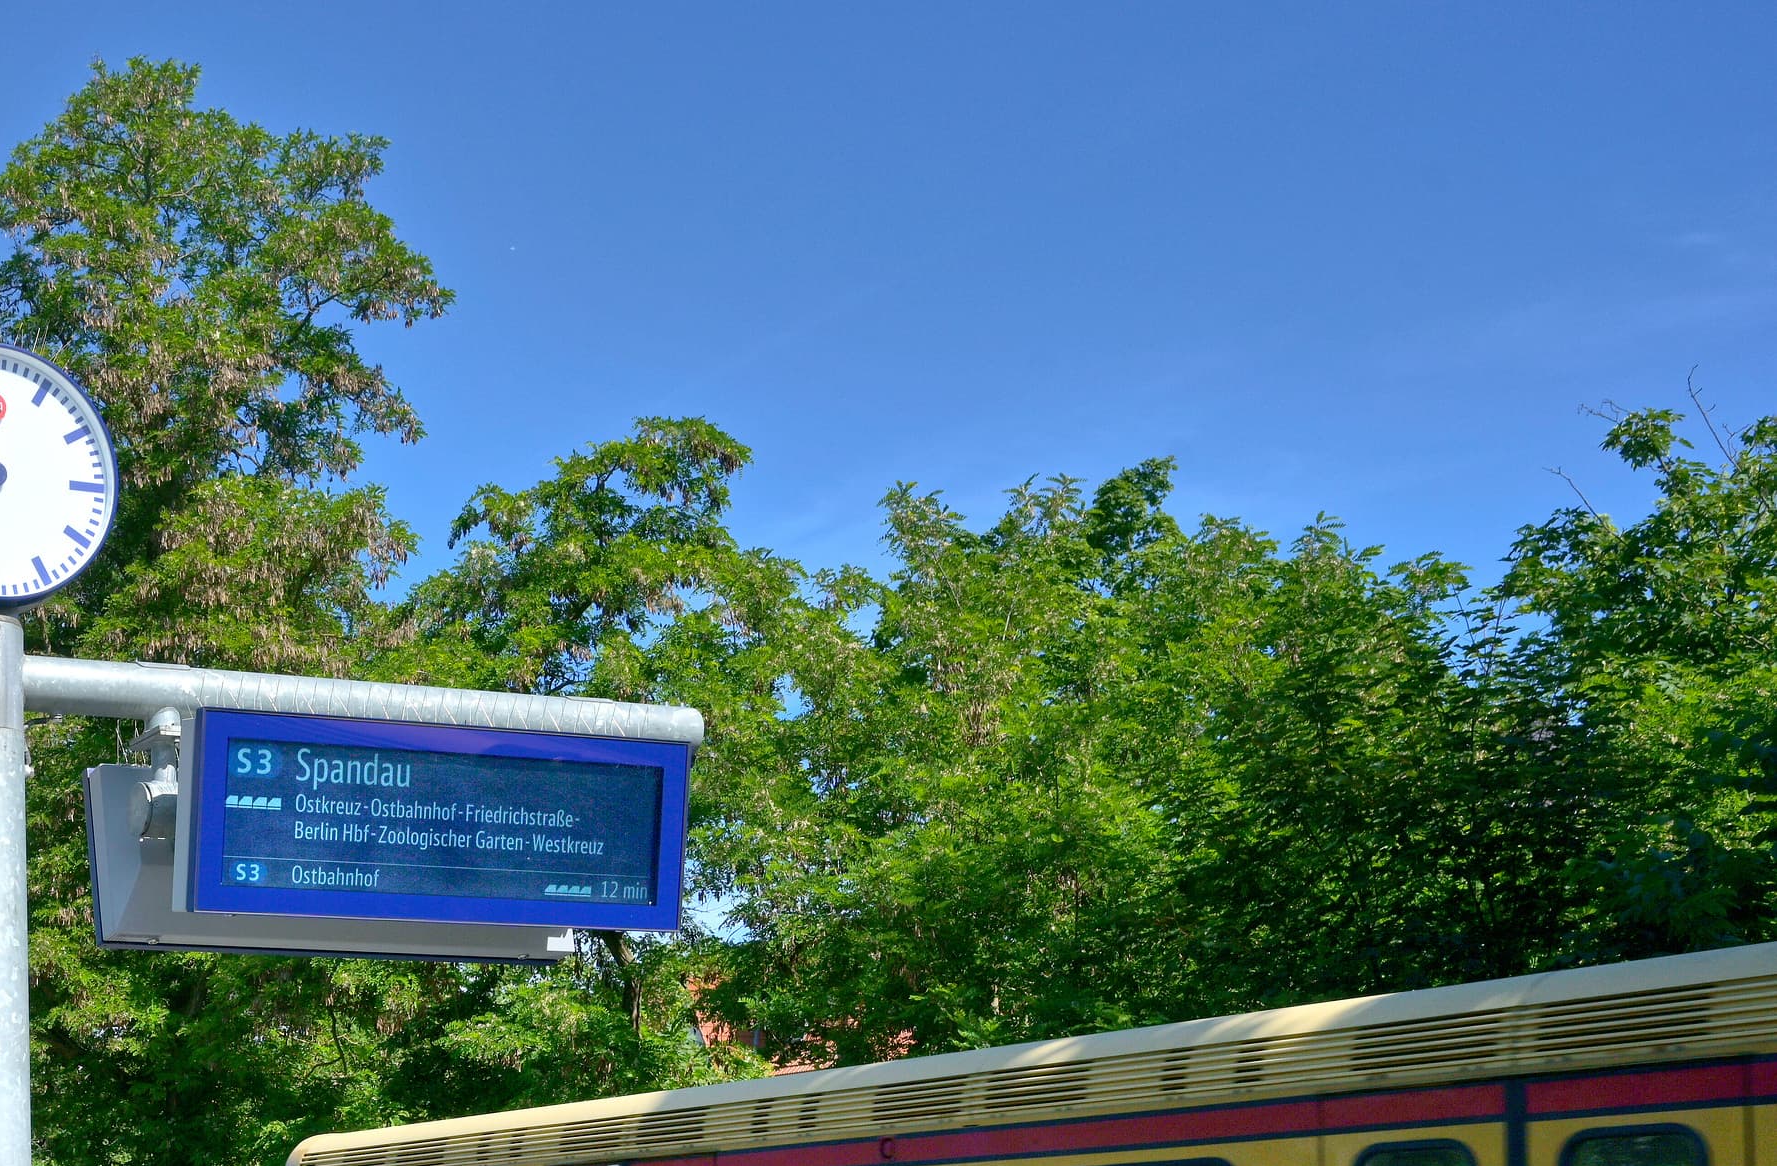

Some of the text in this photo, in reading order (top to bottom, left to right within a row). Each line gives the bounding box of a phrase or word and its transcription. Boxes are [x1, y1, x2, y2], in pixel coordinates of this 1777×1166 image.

[295, 748, 410, 790] Spandau
[294, 821, 338, 841] Berlin
[291, 865, 380, 887] Ostbahnhof
[601, 881, 618, 898] 12
[623, 883, 648, 900] min
